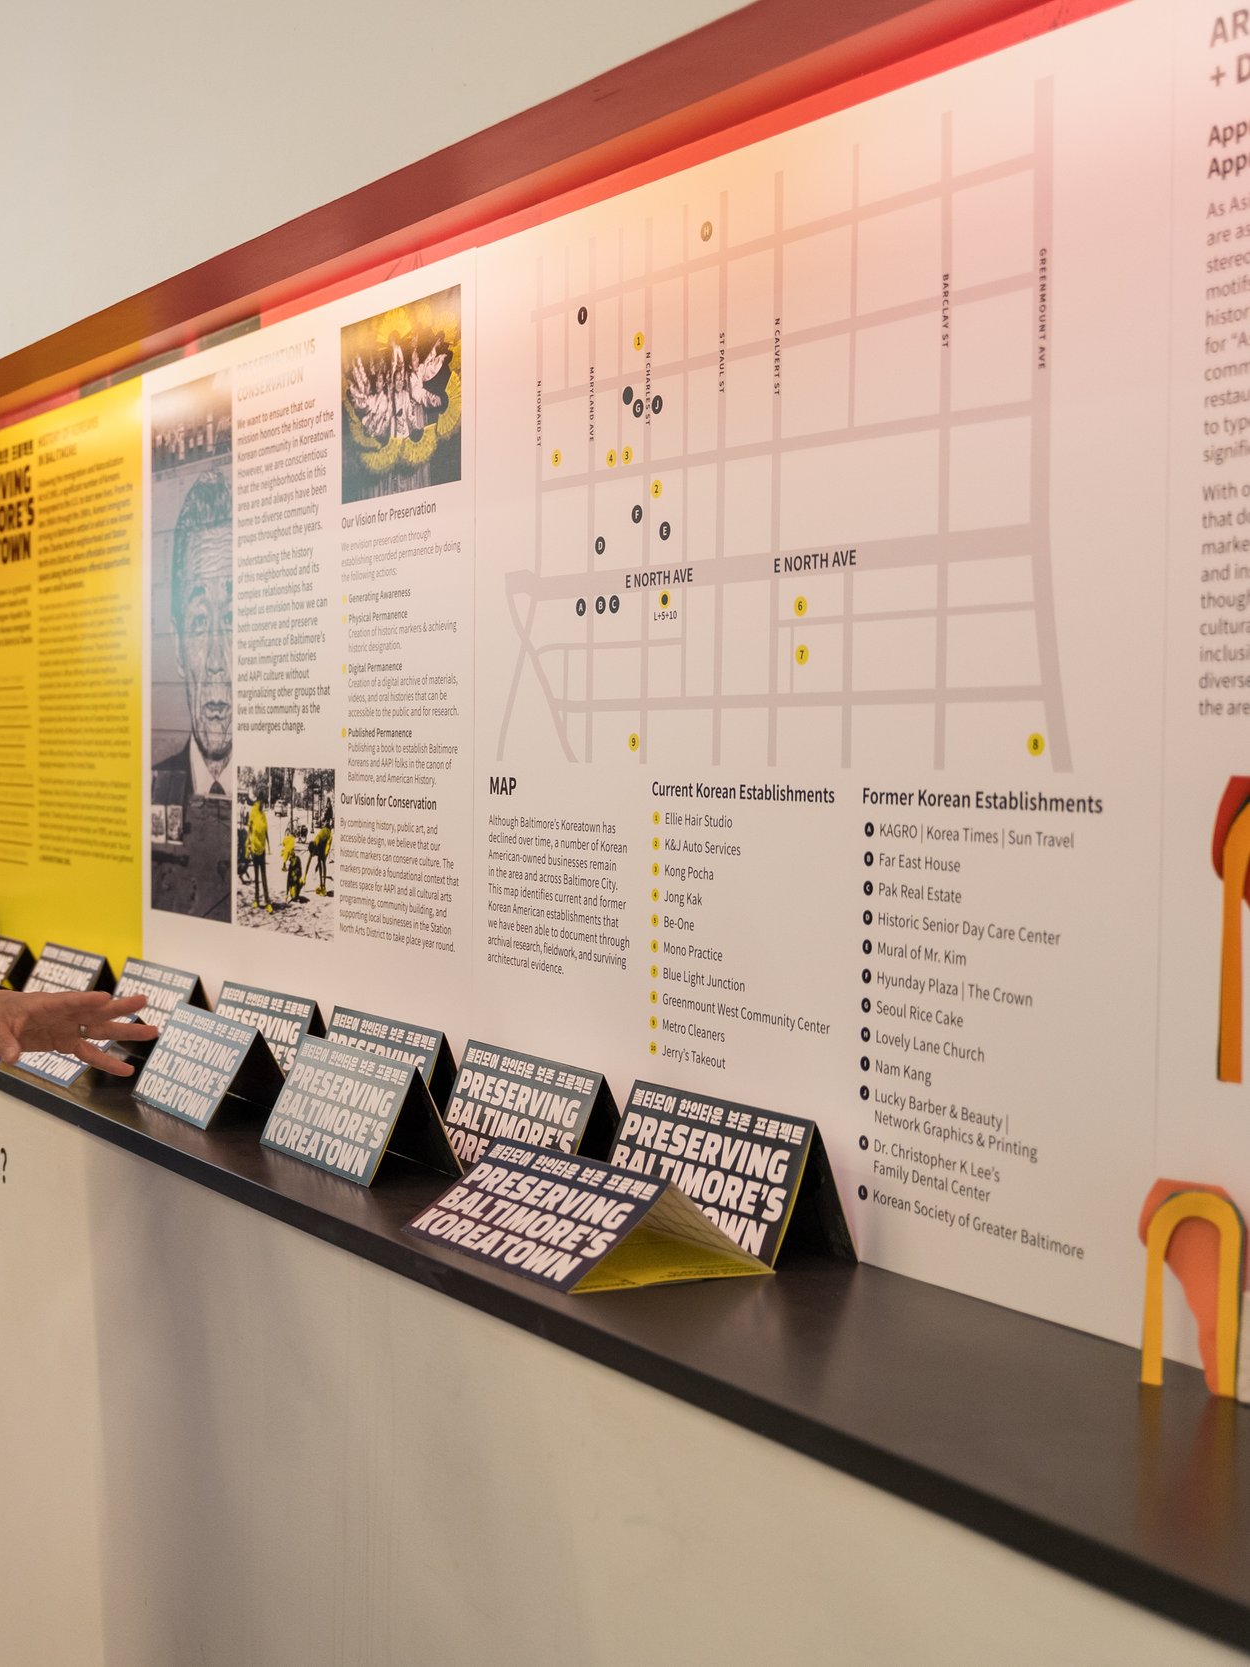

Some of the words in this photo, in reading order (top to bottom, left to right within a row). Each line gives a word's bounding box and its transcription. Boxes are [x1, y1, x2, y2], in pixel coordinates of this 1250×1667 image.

[1039, 248, 1047, 340] GREENMOUNT
[720, 332, 725, 344] ST
[942, 334, 949, 347] ST
[1038, 347, 1046, 369] AVE
[719, 381, 724, 393] ST
[774, 383, 780, 395] ST
[645, 414, 650, 425] ST
[537, 436, 541, 446] ST
[341, 517, 354, 529] Our
[355, 512, 376, 526] Vision
[377, 510, 388, 522] for
[389, 503, 436, 520] Preservation
[774, 558, 781, 573] E
[784, 553, 828, 572] NORTH
[832, 549, 856, 567] AVE
[625, 574, 631, 589] E
[634, 570, 670, 587] NORTH
[672, 567, 693, 583] AVE
[489, 776, 517, 795] MAP
[652, 781, 693, 797] Current
[696, 782, 736, 799] Korean
[739, 784, 835, 803] Establishments
[340, 792, 353, 804] Our
[354, 793, 375, 806] Vision
[376, 793, 387, 807] for
[388, 795, 437, 810] Conservation
[862, 787, 914, 806] Former
[918, 789, 971, 808] Korean
[975, 791, 1103, 813] Establishments
[488, 814, 519, 830] Although
[520, 816, 560, 830] Baltimore's
[560, 819, 601, 832] Koreatown
[602, 821, 616, 834] has
[665, 812, 683, 825] Ellie
[684, 813, 702, 826] Hair
[704, 814, 733, 828] Studio
[664, 838, 681, 851] K&J
[682, 840, 703, 853] Auto
[704, 841, 741, 856] Services
[879, 823, 918, 839] KAGRO
[926, 826, 960, 841] Korea
[962, 827, 998, 844] Times
[1008, 830, 1032, 845] Sun
[1035, 831, 1074, 848] Travel
[664, 864, 686, 882] Kong
[687, 866, 714, 880] Pocha
[879, 852, 896, 867] Far
[898, 854, 922, 870] East
[924, 856, 961, 872] House
[663, 890, 685, 907] Jong
[686, 892, 703, 906] Kak
[878, 882, 898, 897] Pak
[900, 884, 924, 900] Real
[927, 886, 962, 903] Estate
[663, 915, 694, 931] Be-One
[878, 912, 919, 930] Historic
[922, 916, 960, 934] Senior
[962, 920, 985, 941] Day
[987, 923, 1015, 940] Care
[1018, 926, 1061, 945] Center
[663, 941, 686, 956] Mono
[688, 945, 723, 962] Practice
[877, 941, 907, 958] Mural
[910, 945, 922, 960] of
[924, 947, 941, 963] Mr.
[944, 950, 967, 966] Kim
[662, 967, 682, 982] Blue
[683, 970, 705, 988] Light
[706, 974, 745, 992] Junction
[876, 971, 926, 994] Hyunday
[928, 978, 958, 996] Plaza
[967, 983, 990, 1001] The
[992, 987, 1033, 1006] Crown
[662, 993, 716, 1014] Greenmount
[717, 1002, 739, 1018] West
[740, 1007, 795, 1031] Community
[797, 1017, 830, 1034] Center
[876, 1000, 906, 1018] Seoul
[909, 1005, 933, 1022] Rice
[935, 1009, 964, 1028] Cake
[662, 1018, 686, 1034] Metro
[687, 1023, 725, 1042] Cleaners
[159, 1026, 239, 1072] PRESERVING
[661, 1045, 689, 1063] Jerry's
[690, 1050, 726, 1069] Takeout
[875, 1030, 910, 1052] Lovely
[913, 1036, 940, 1054] Lane
[942, 1041, 985, 1062] Church
[148, 1049, 230, 1098] BALTIMORE'S
[875, 1059, 900, 1077] Nam
[903, 1065, 932, 1087] Kang
[136, 1071, 214, 1121] KOREATOWN
[288, 1063, 396, 1118] PRESERVING
[456, 1068, 581, 1128] PRESERVING
[276, 1089, 388, 1149] BALTIMORE'S
[632, 1089, 676, 1113] 볼티모어
[677, 1099, 724, 1125] 한인타운
[725, 1110, 752, 1133] 보존
[753, 1117, 805, 1145] 프로젝트
[875, 1088, 906, 1111] Lucky
[908, 1095, 947, 1116] Barber
[949, 1104, 958, 1119] &
[961, 1106, 1003, 1132] Beauty
[446, 1097, 575, 1155] BALTIMORE'S
[874, 1110, 920, 1132] Network
[923, 1120, 974, 1144] Graphics
[976, 1132, 985, 1148] &
[988, 1135, 1038, 1163] Printing
[265, 1116, 371, 1177] KOREATOWN
[619, 1112, 790, 1184] PRESERVING
[488, 1144, 536, 1167] 볼티모어
[532, 1155, 580, 1180] 한인타운
[577, 1166, 608, 1187] 보존
[603, 1175, 659, 1200] 프로젝트
[874, 1138, 888, 1155] Dr.
[890, 1143, 957, 1171] Christopher
[959, 1160, 968, 1174] K
[970, 1162, 1000, 1182] Lee's
[873, 1160, 909, 1184] Family
[911, 1169, 948, 1192] Dental
[950, 1180, 990, 1202] Center
[462, 1162, 635, 1230] PRESERVING
[438, 1187, 617, 1258] BALTIMORE'S
[872, 1189, 911, 1212] Korean
[913, 1200, 956, 1227] Society
[957, 1213, 970, 1228] of
[972, 1216, 1018, 1240] Greater
[1020, 1229, 1084, 1259] Baltimore
[412, 1208, 582, 1282] KOREATOWN
